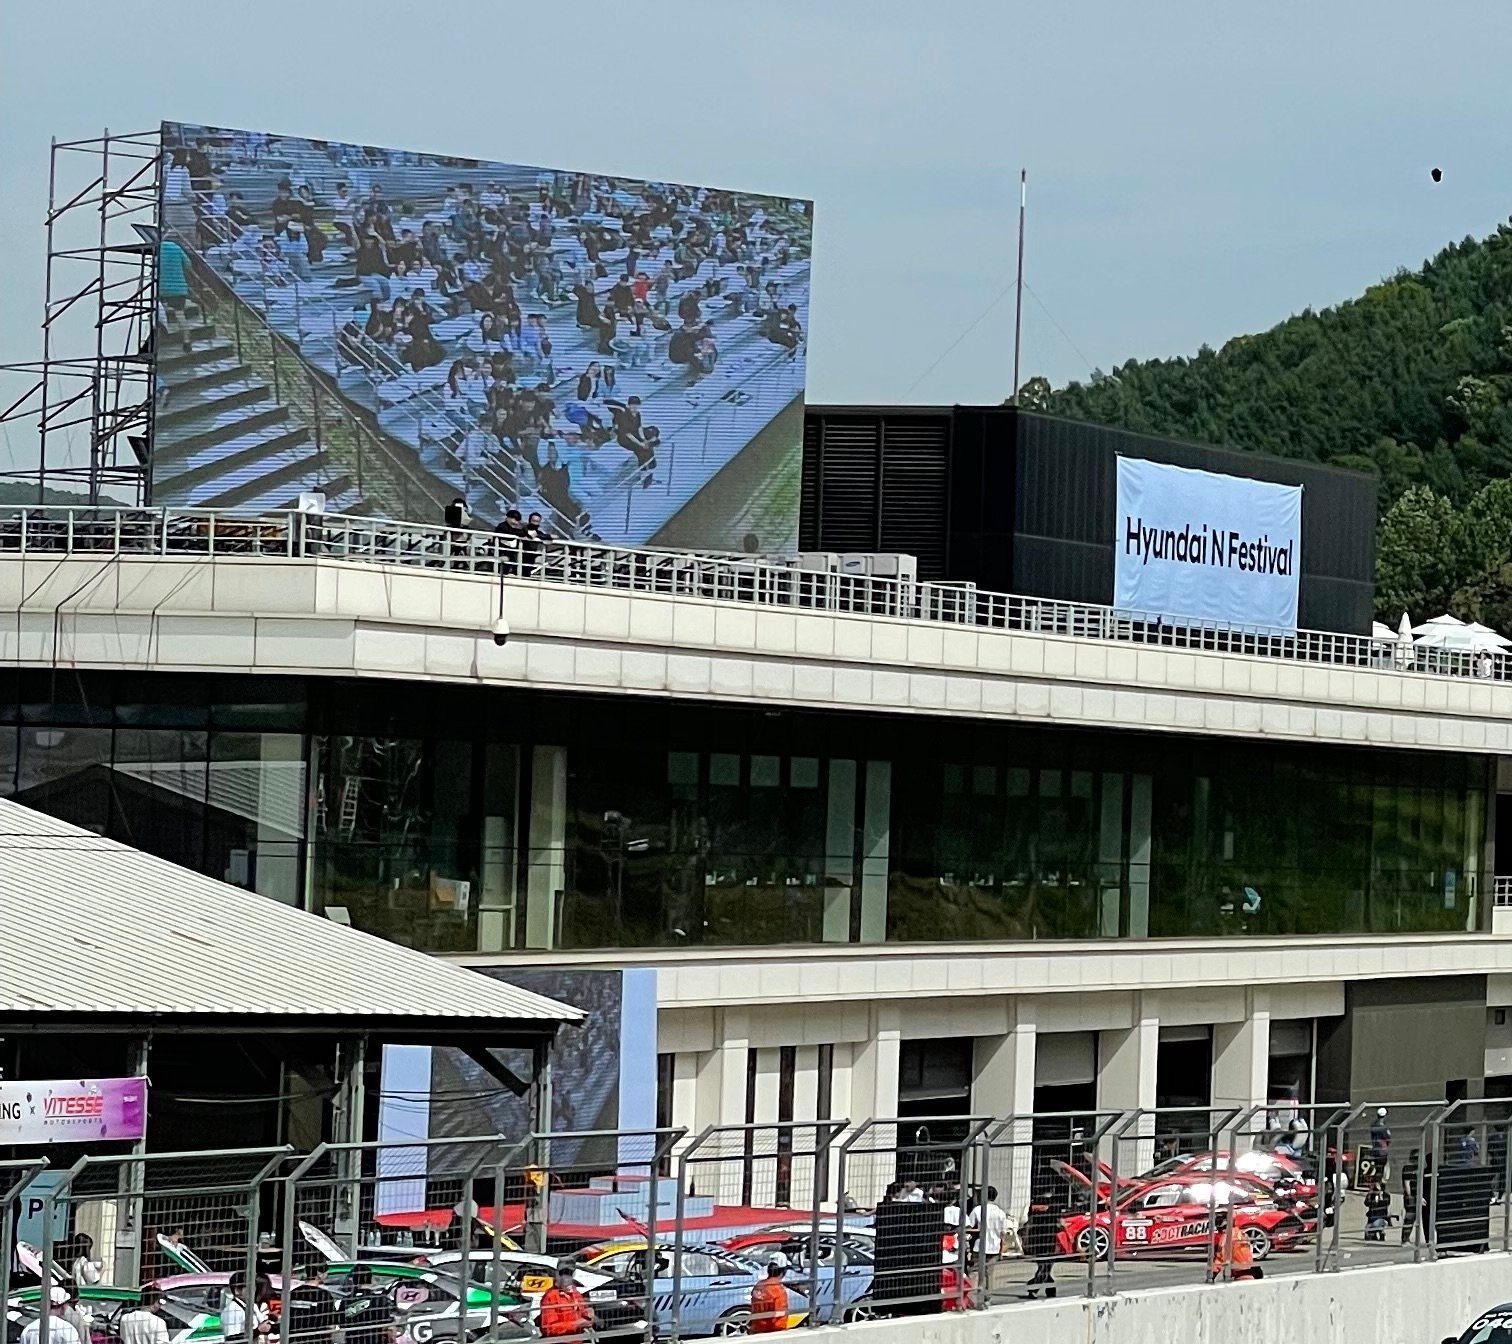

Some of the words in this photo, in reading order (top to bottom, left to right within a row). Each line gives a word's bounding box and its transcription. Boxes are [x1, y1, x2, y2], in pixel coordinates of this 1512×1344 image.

[1126, 516, 1207, 565] Hyundai
[1211, 529, 1225, 567] N
[1228, 531, 1293, 576] Festival
[44, 1096, 104, 1115] VITESSE
[1125, 1225, 1147, 1241] 88
